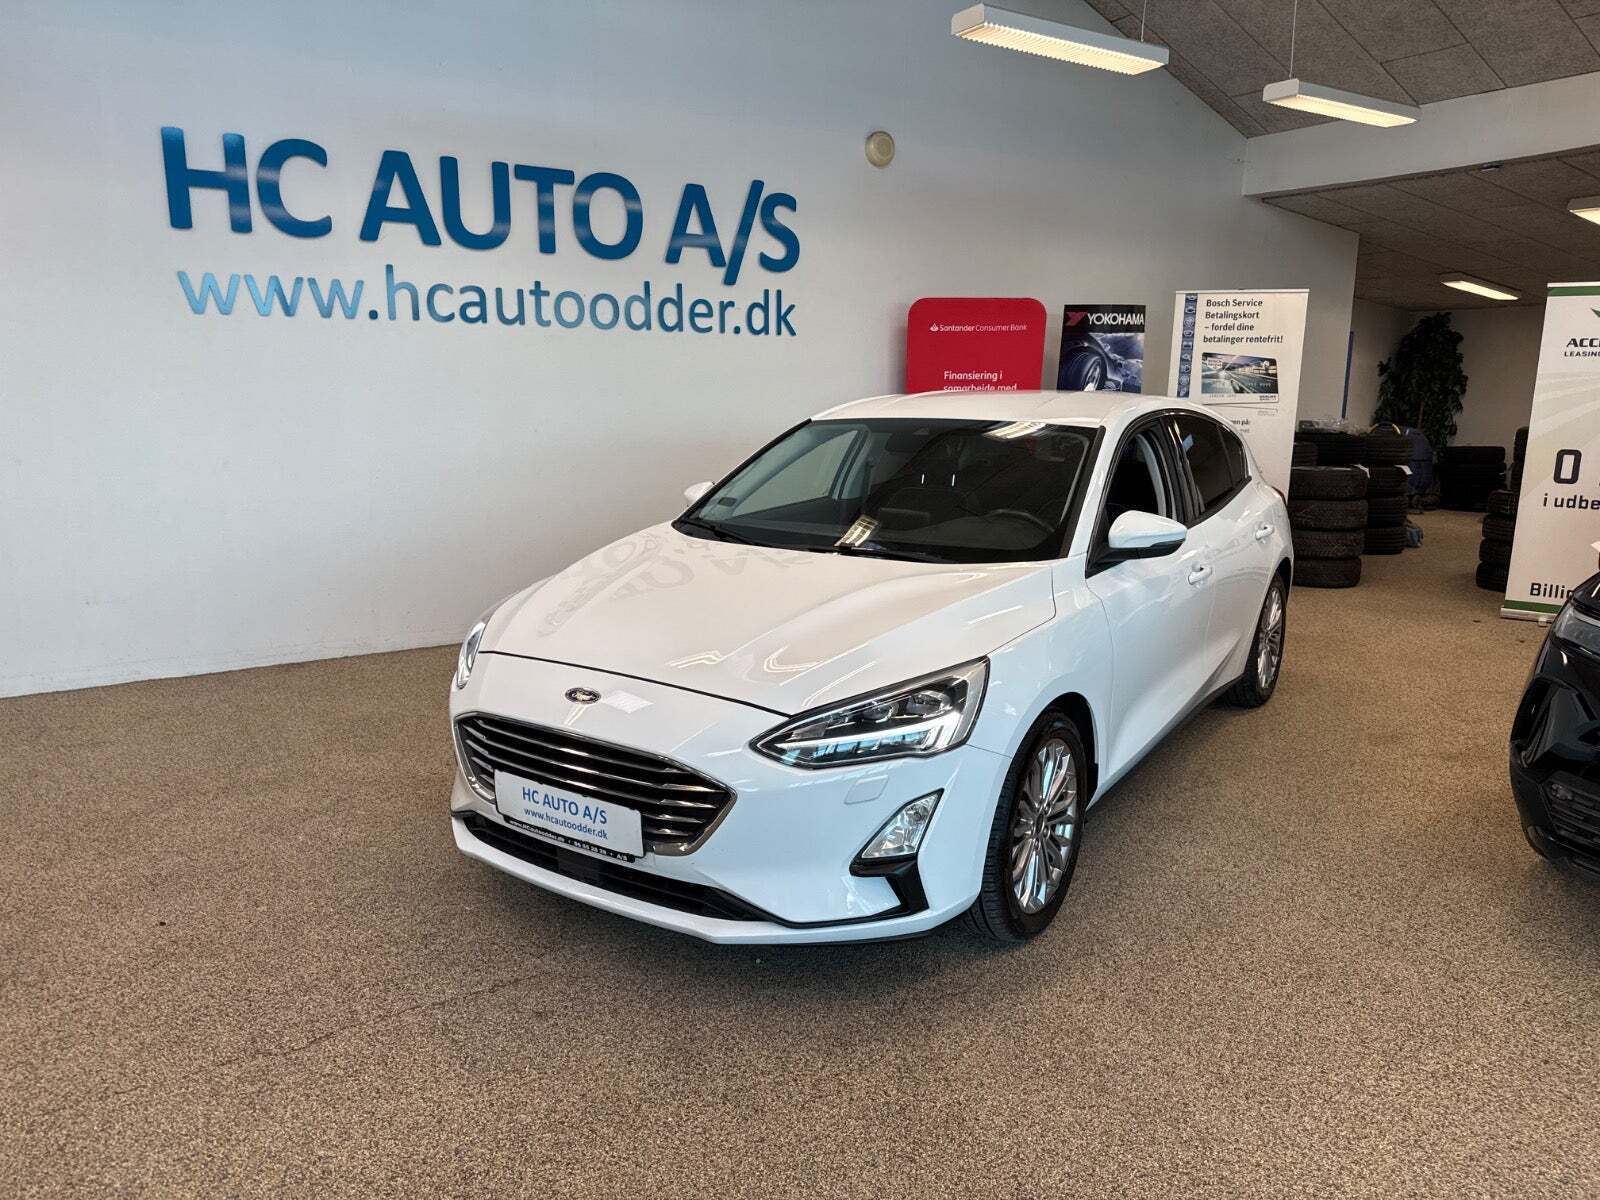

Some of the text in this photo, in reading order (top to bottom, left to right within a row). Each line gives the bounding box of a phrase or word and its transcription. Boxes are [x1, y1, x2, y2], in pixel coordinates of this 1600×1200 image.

[160, 126, 801, 286] HC AUTO A/S
[177, 263, 797, 337] www.hcautoodder.dk
[1206, 298, 1263, 307] Bosch Service
[1087, 313, 1144, 326] YOKOHAMA
[1205, 311, 1259, 320] Betalingskort
[939, 324, 975, 332] Santander
[1211, 322, 1236, 331] fordel
[1236, 323, 1255, 331] dine
[1203, 335, 1284, 344] betalinger rentefrit!
[1566, 338, 1600, 347] ACC
[943, 370, 1003, 382] Finansiering i
[1553, 449, 1582, 484] 0
[1543, 493, 1548, 507] i
[522, 787, 608, 825] HC AUTO A/S
[523, 807, 608, 840] www.hcautoodder.dk
